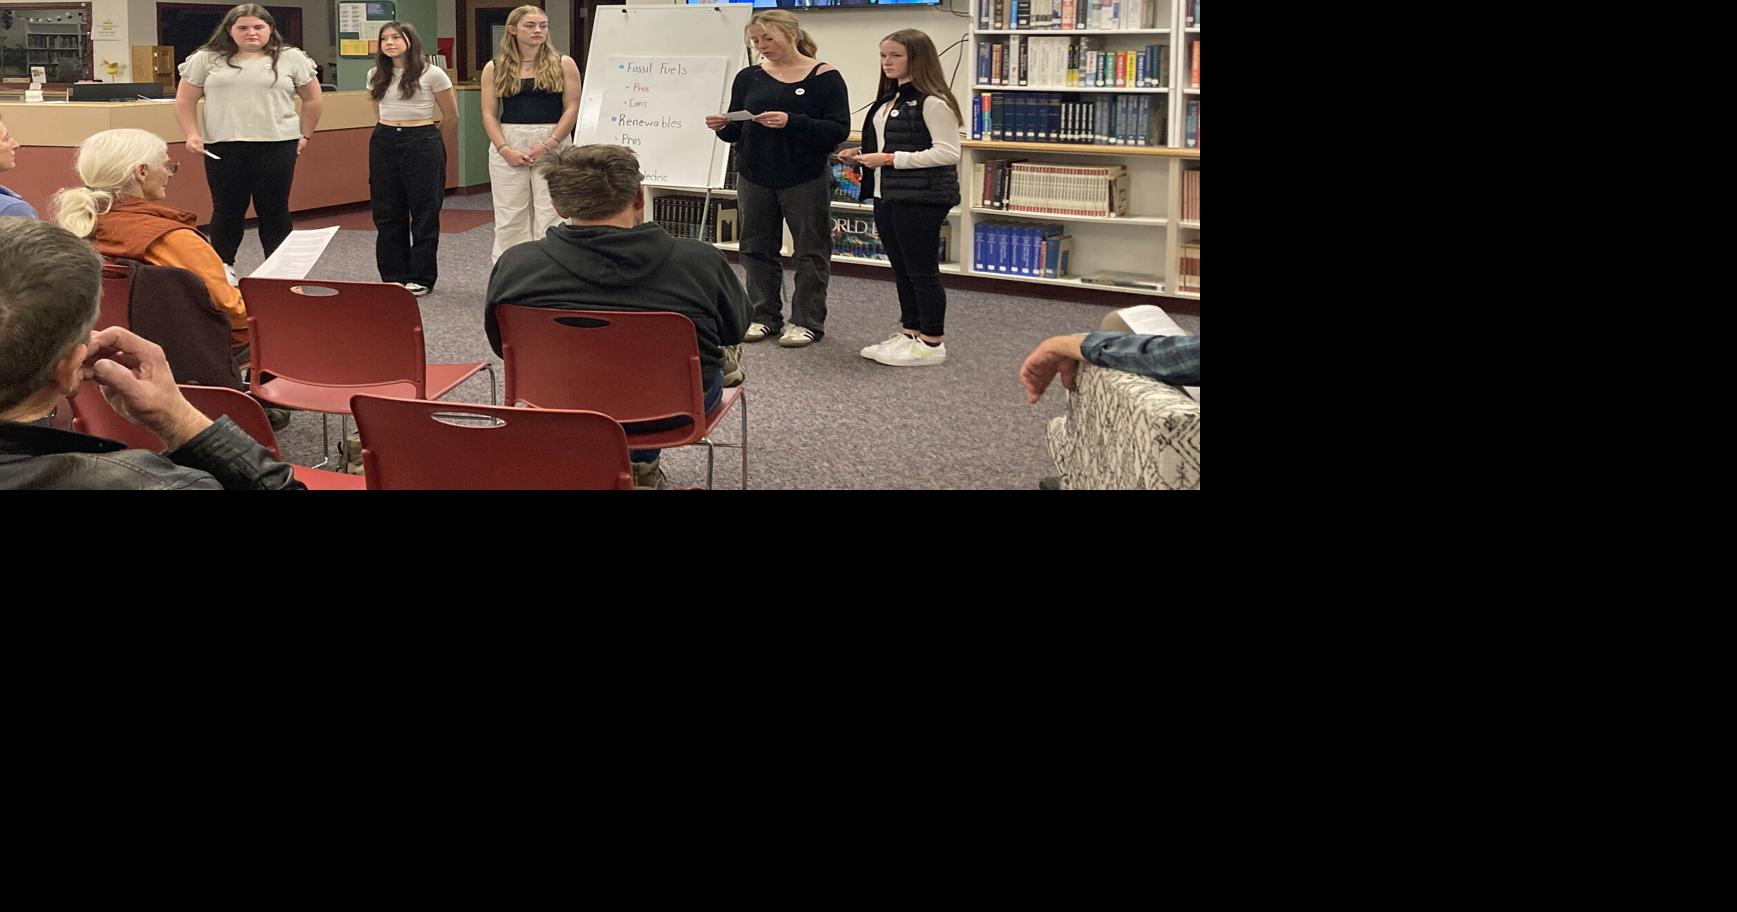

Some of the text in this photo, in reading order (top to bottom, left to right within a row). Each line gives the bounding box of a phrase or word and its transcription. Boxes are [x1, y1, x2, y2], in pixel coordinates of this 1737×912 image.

[627, 62, 688, 75] Fossil Fuels
[633, 82, 650, 93] Pros
[618, 113, 682, 129] Renewables
[621, 133, 641, 145] Pros
